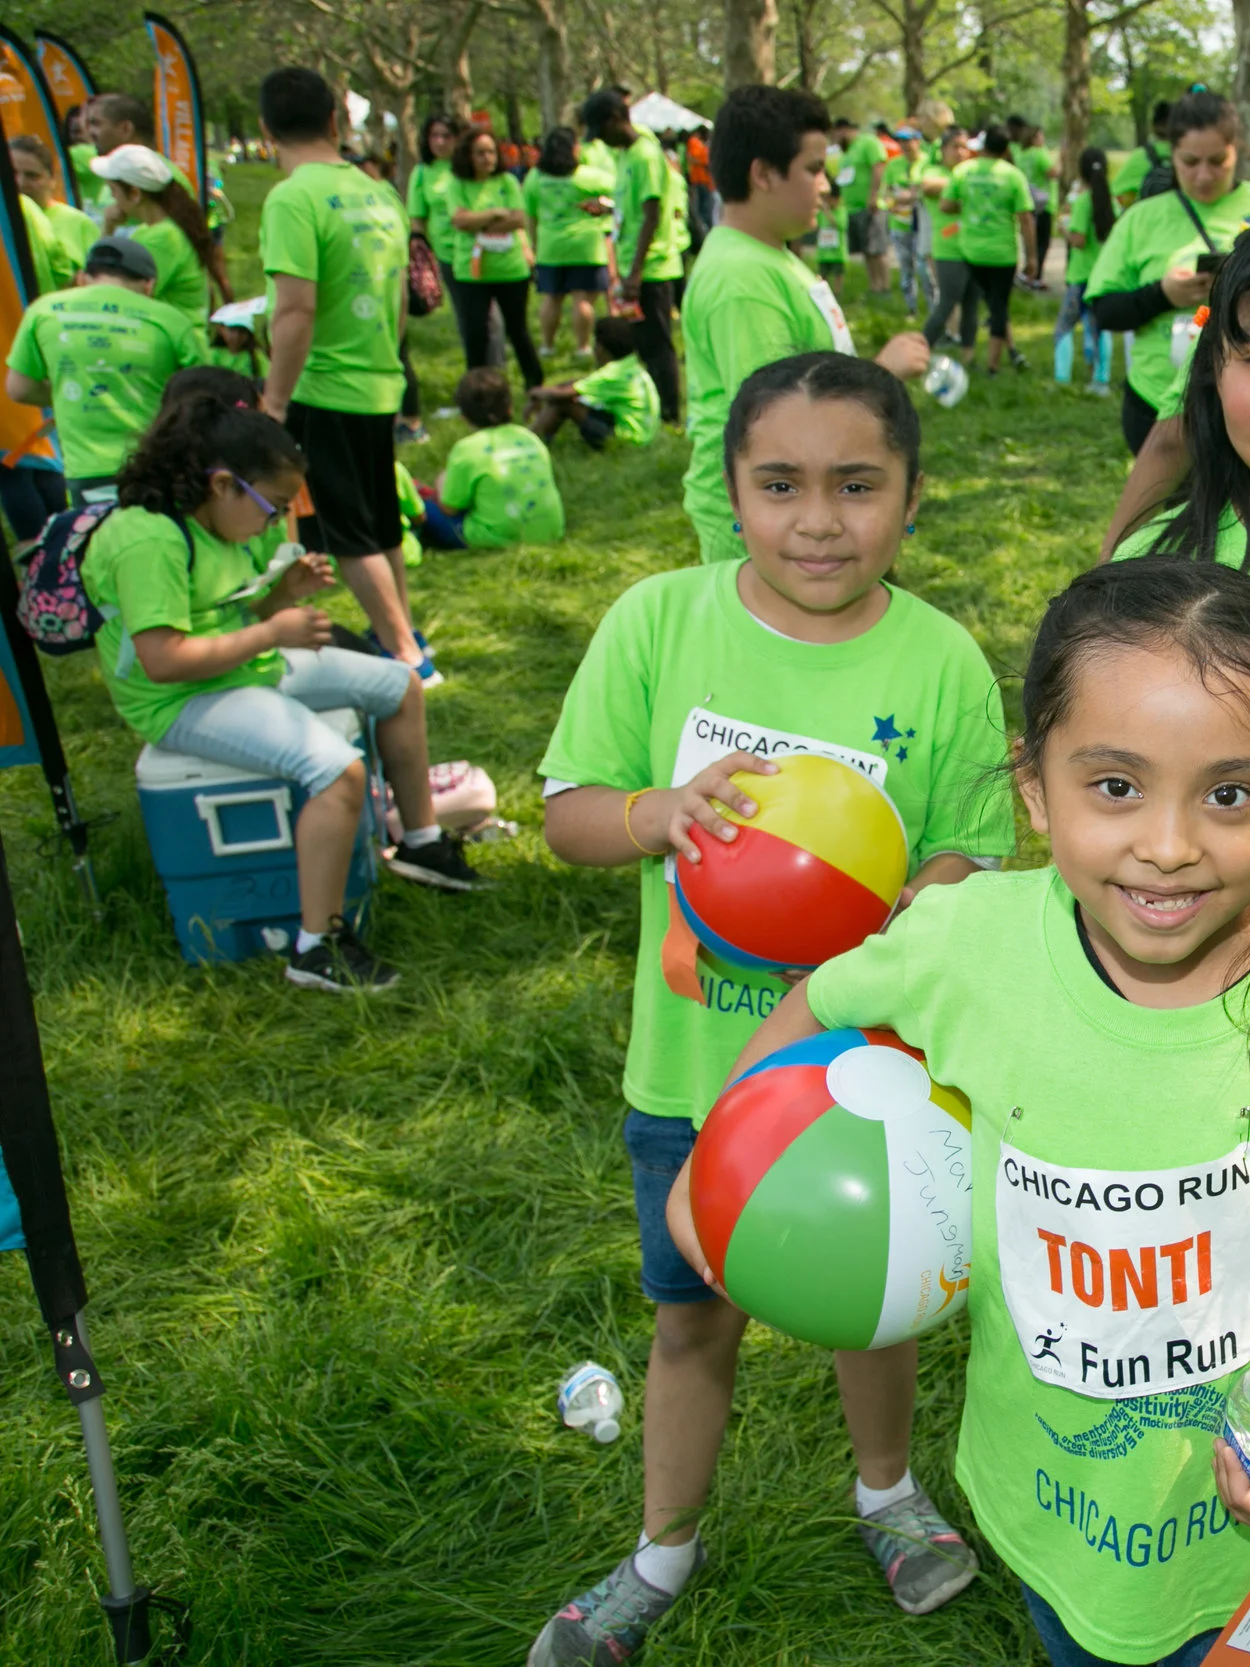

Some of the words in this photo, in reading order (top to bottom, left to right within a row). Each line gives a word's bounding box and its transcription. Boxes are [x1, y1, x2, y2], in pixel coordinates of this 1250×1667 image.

[700, 975, 789, 1020] ICAG
[1004, 1158, 1164, 1212] CHICAGO
[1178, 1161, 1250, 1206] RUN
[1037, 1227, 1213, 1312] TONTI
[1080, 1341, 1151, 1388] Fun
[1166, 1331, 1238, 1379] Run
[1072, 1406, 1122, 1443] mentoring
[1118, 1406, 1145, 1440] active
[1088, 1441, 1128, 1460] diversity
[1036, 1468, 1178, 1568] CHICAGO
[1185, 1495, 1241, 1548] RU
